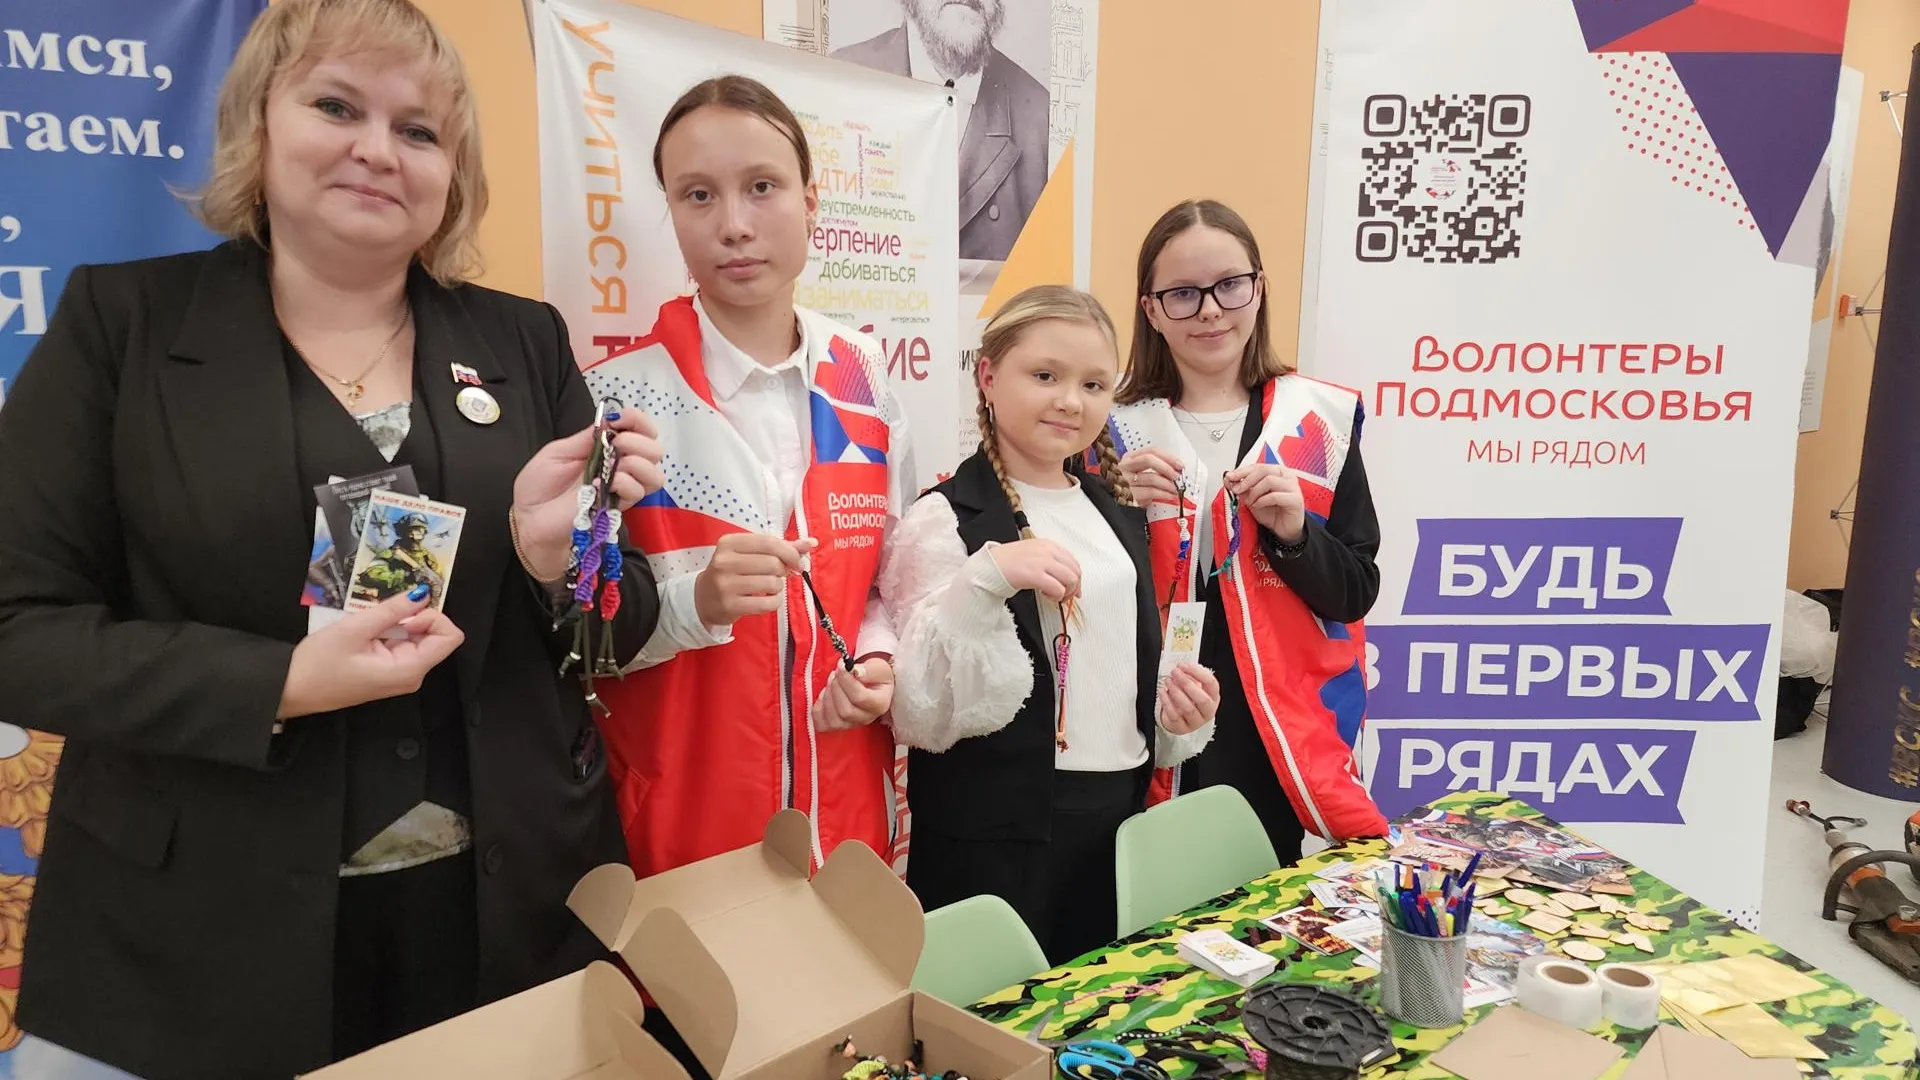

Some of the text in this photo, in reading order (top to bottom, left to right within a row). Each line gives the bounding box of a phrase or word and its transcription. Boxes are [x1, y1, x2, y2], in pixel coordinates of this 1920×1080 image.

[0, 29, 173, 91] мся,
[561, 17, 627, 314] УЧИТЬСЯ
[817, 167, 858, 196] дти
[820, 199, 916, 223] еустремленность
[812, 226, 902, 258] ерпение
[818, 258, 917, 284] добиваться
[1412, 335, 1724, 375] ВОЛОНТЕРЫ
[1375, 381, 1752, 422] ПОДМОСКОВЬЯ
[1467, 440, 1646, 469] МЫ РЯДОМ
[833, 537, 849, 550] МЫ
[1438, 543, 1654, 609] БУДЬ
[1407, 641, 1753, 703] ПЕРВЫХ
[1398, 738, 1667, 803] РЯДАХ
